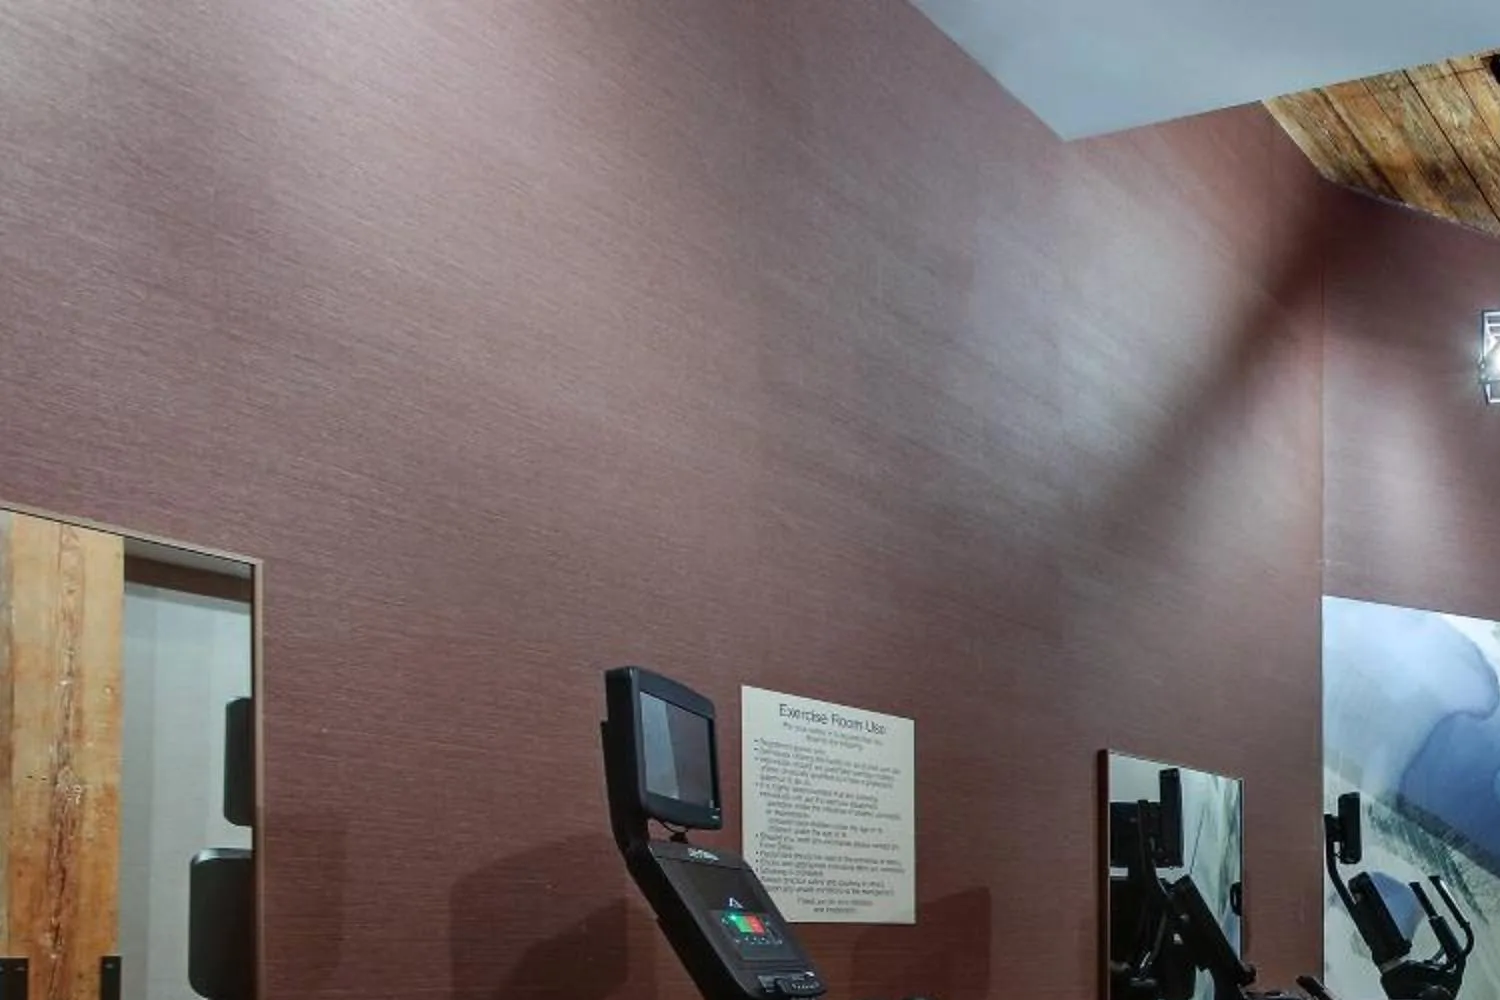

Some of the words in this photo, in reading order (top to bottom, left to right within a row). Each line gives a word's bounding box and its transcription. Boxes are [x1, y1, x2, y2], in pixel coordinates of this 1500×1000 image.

[779, 703, 828, 725] Exercise
[831, 713, 863, 732] Room
[865, 720, 887, 735] Use
